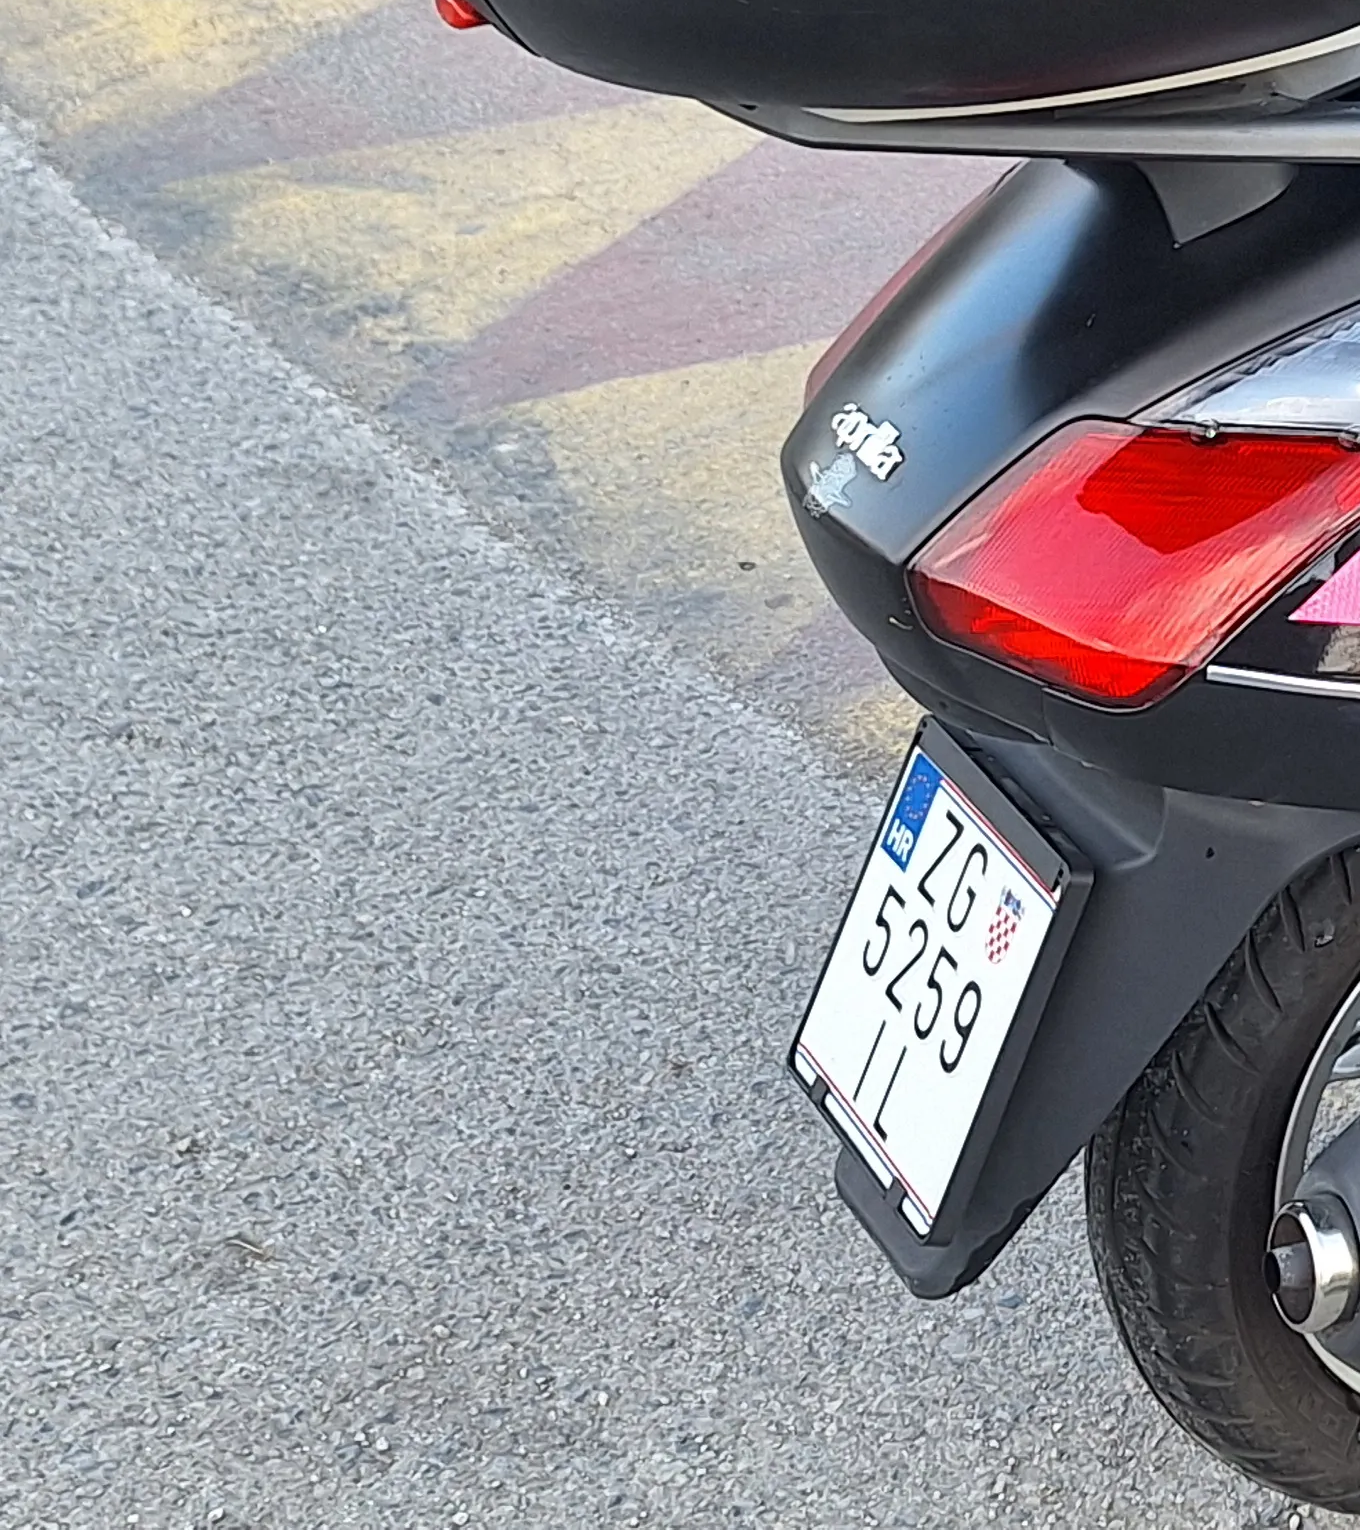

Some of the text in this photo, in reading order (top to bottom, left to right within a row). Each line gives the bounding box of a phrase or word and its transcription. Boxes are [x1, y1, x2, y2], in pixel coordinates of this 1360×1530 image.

[886, 818, 914, 862] HR
[917, 809, 989, 933] ZG
[862, 883, 983, 1074] 5259
